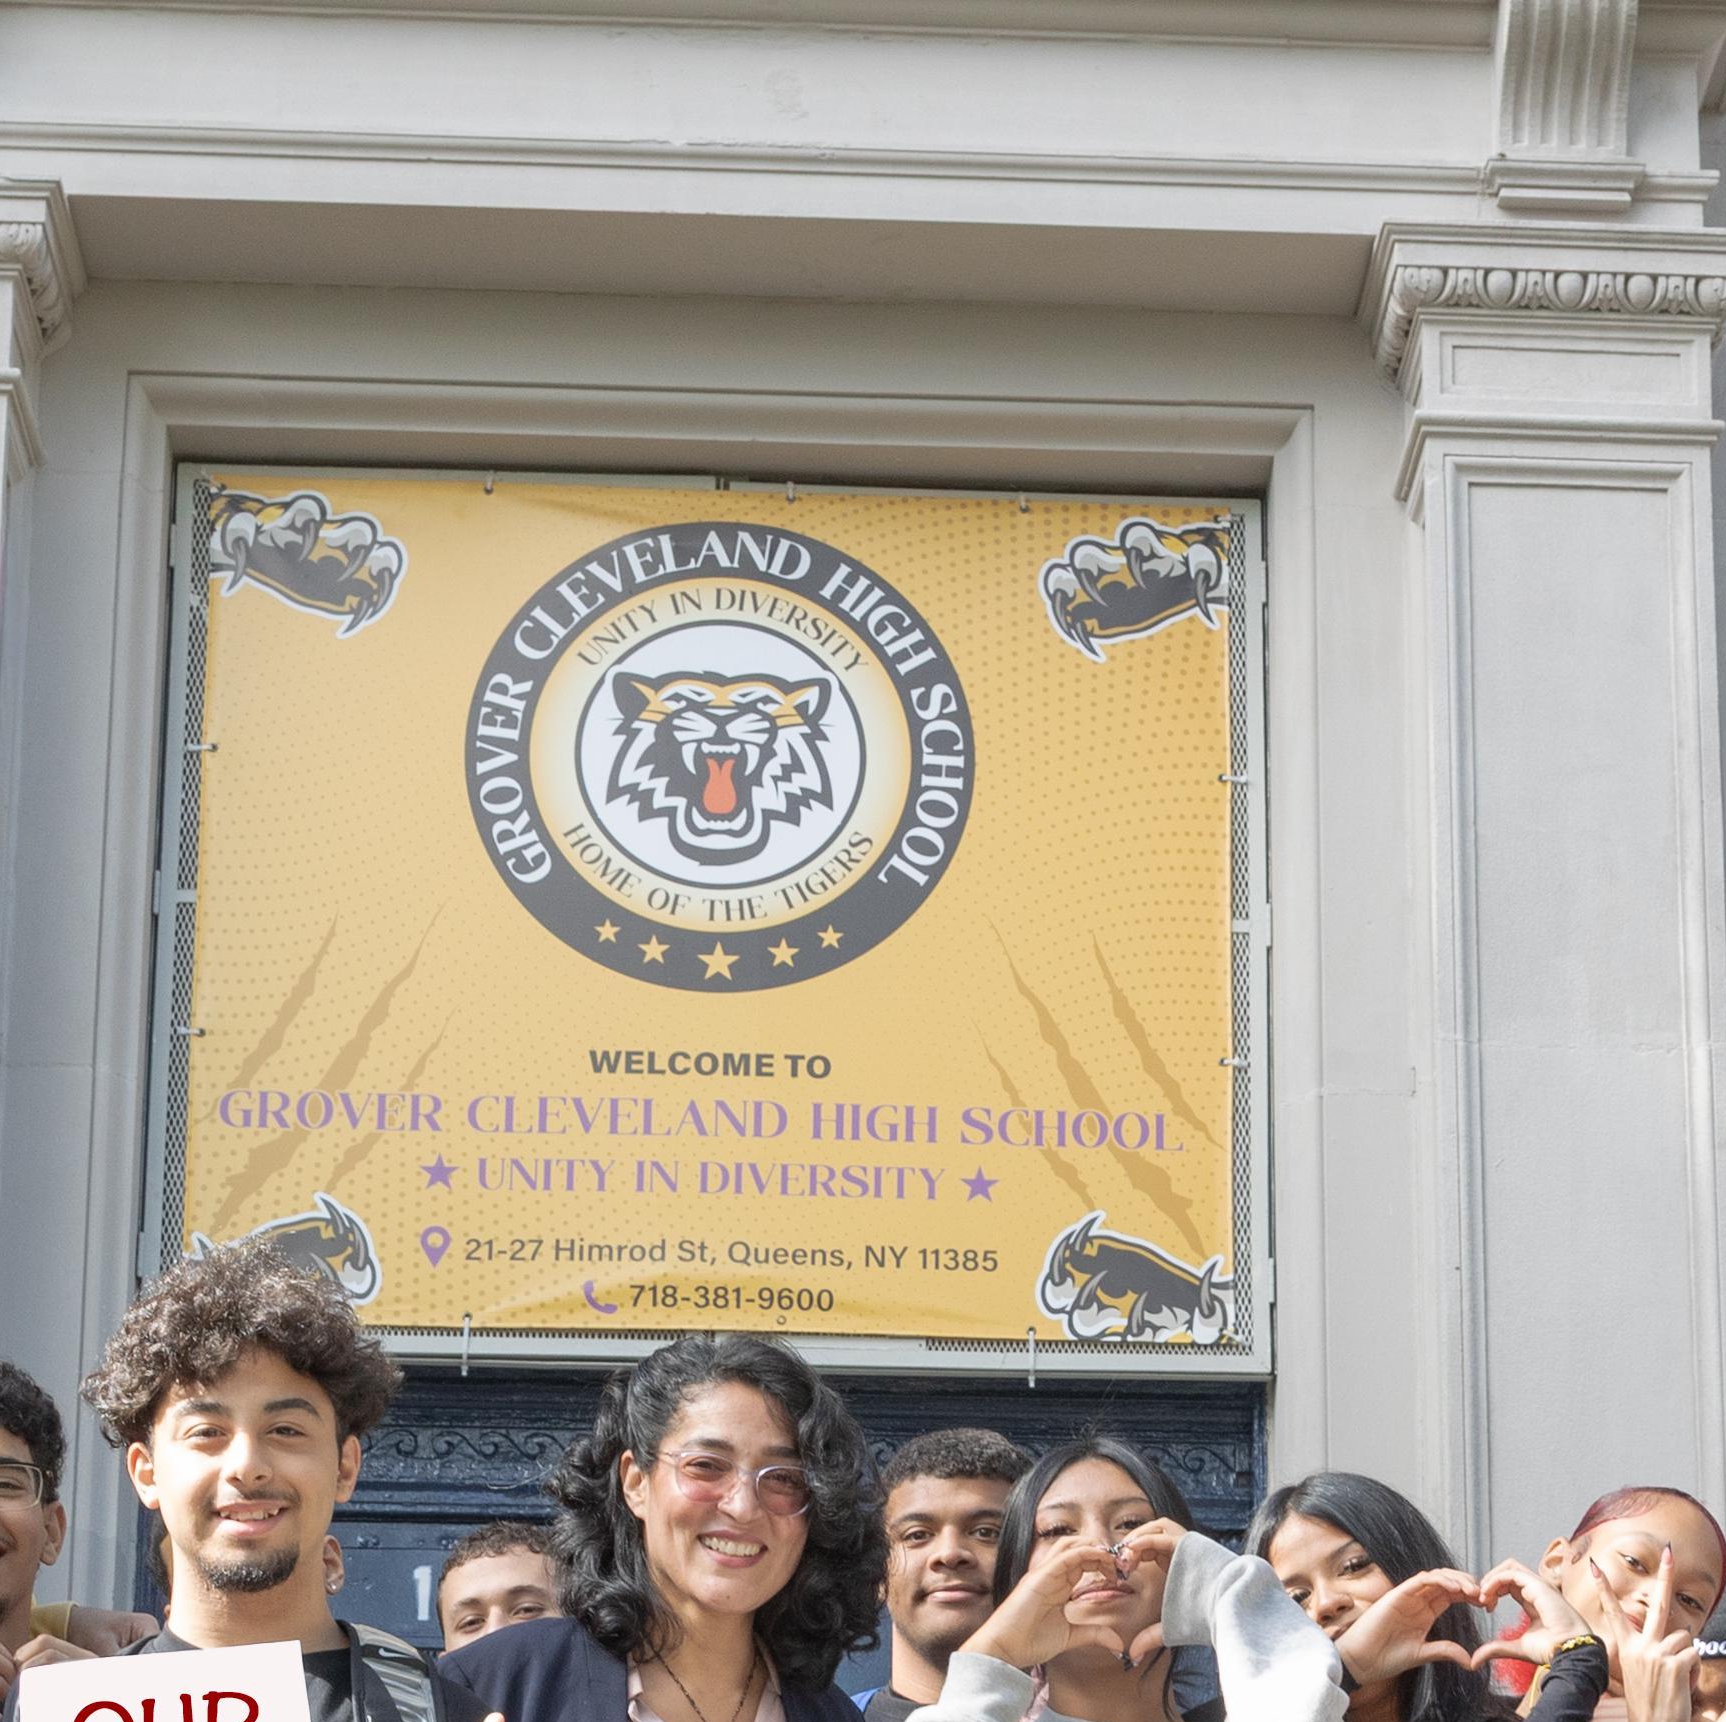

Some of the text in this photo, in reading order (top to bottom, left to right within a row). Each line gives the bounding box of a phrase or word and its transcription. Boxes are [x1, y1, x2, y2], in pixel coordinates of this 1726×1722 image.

[576, 586, 870, 674] UNITY IN DIVERSITY
[476, 529, 965, 888] GROVER CLEVELAND HIGH SCHOOL
[562, 822, 874, 922] HOME OF THE TIGERS
[589, 1050, 832, 1079] WELCOME TO
[219, 1089, 1184, 1152] GROVER CLEVELAND HIGH SCHOOL
[478, 1157, 946, 1200] UNITY IN DIVERSITY
[465, 1238, 999, 1273] 21-27 Himrod St, Queens, NY 11385
[629, 1284, 835, 1312] 718-381-9600
